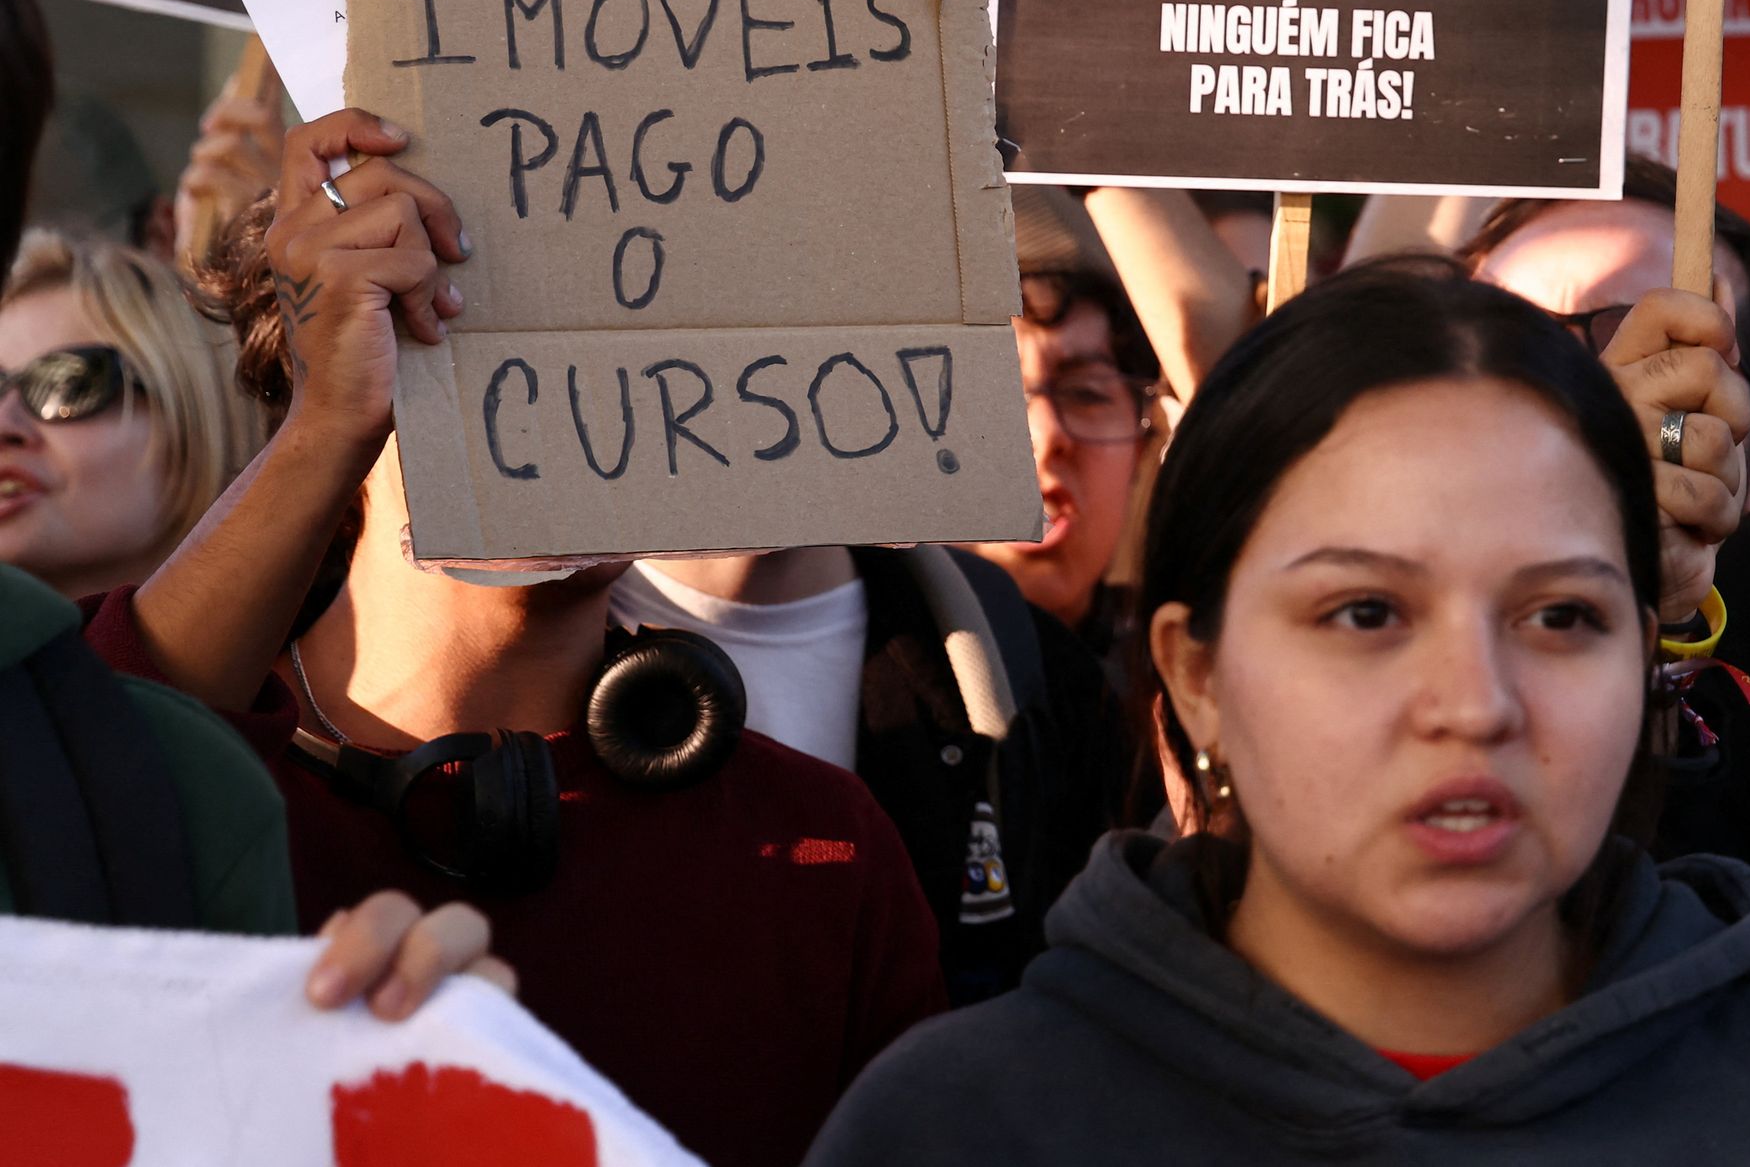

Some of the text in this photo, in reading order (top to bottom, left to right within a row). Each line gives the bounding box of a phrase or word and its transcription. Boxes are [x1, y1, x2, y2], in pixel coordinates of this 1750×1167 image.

[1352, 10, 1436, 61] FICA
[1190, 60, 1415, 120] PARA TRÁS!
[480, 109, 765, 221] PAGO
[612, 226, 665, 310] O
[483, 345, 961, 480] CURSO!
